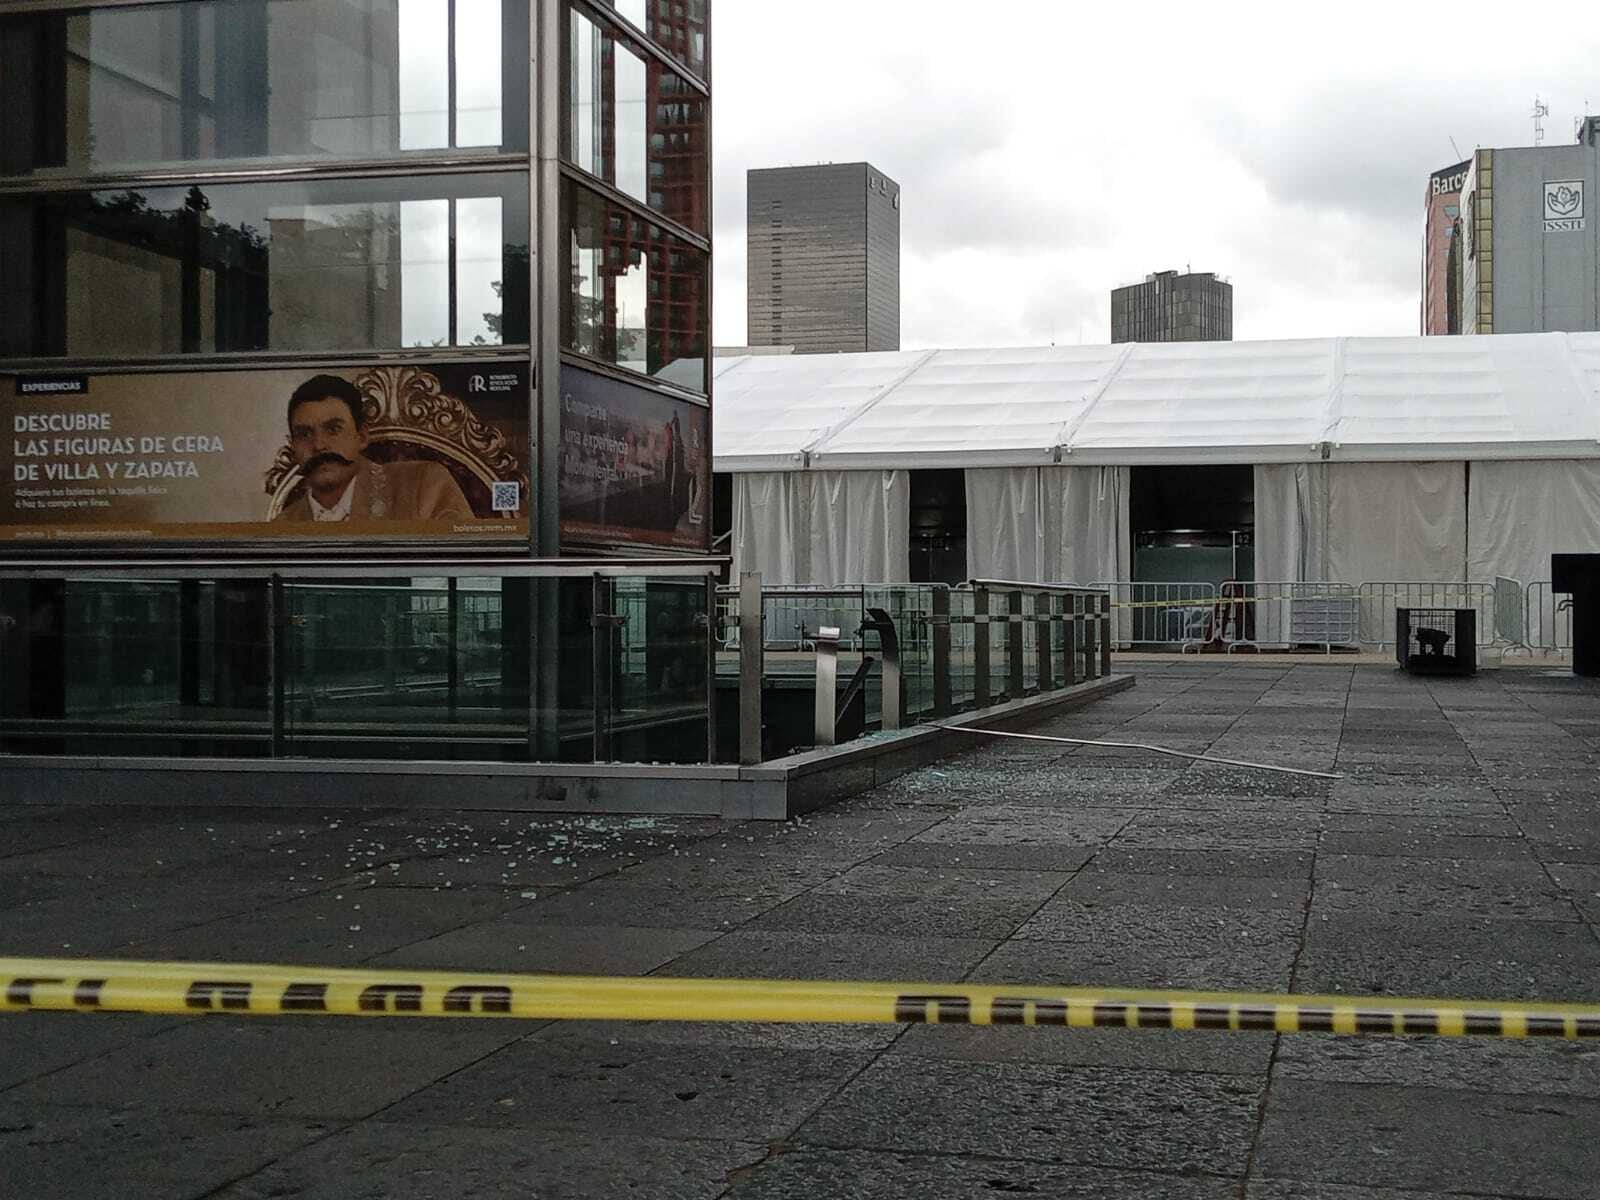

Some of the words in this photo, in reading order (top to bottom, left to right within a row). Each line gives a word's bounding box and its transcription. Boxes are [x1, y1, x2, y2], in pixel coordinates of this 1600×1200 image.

[22, 381, 81, 392] EXPERIENCIAS
[14, 413, 112, 432] DESCUBRE
[14, 439, 49, 457] LAS
[54, 436, 135, 456] FIGURAS
[140, 436, 165, 454] DE
[172, 435, 225, 453] CERA
[14, 463, 40, 481] DE
[44, 462, 100, 481] VILLA
[104, 462, 119, 479] Y
[123, 460, 200, 479] ZAPATA
